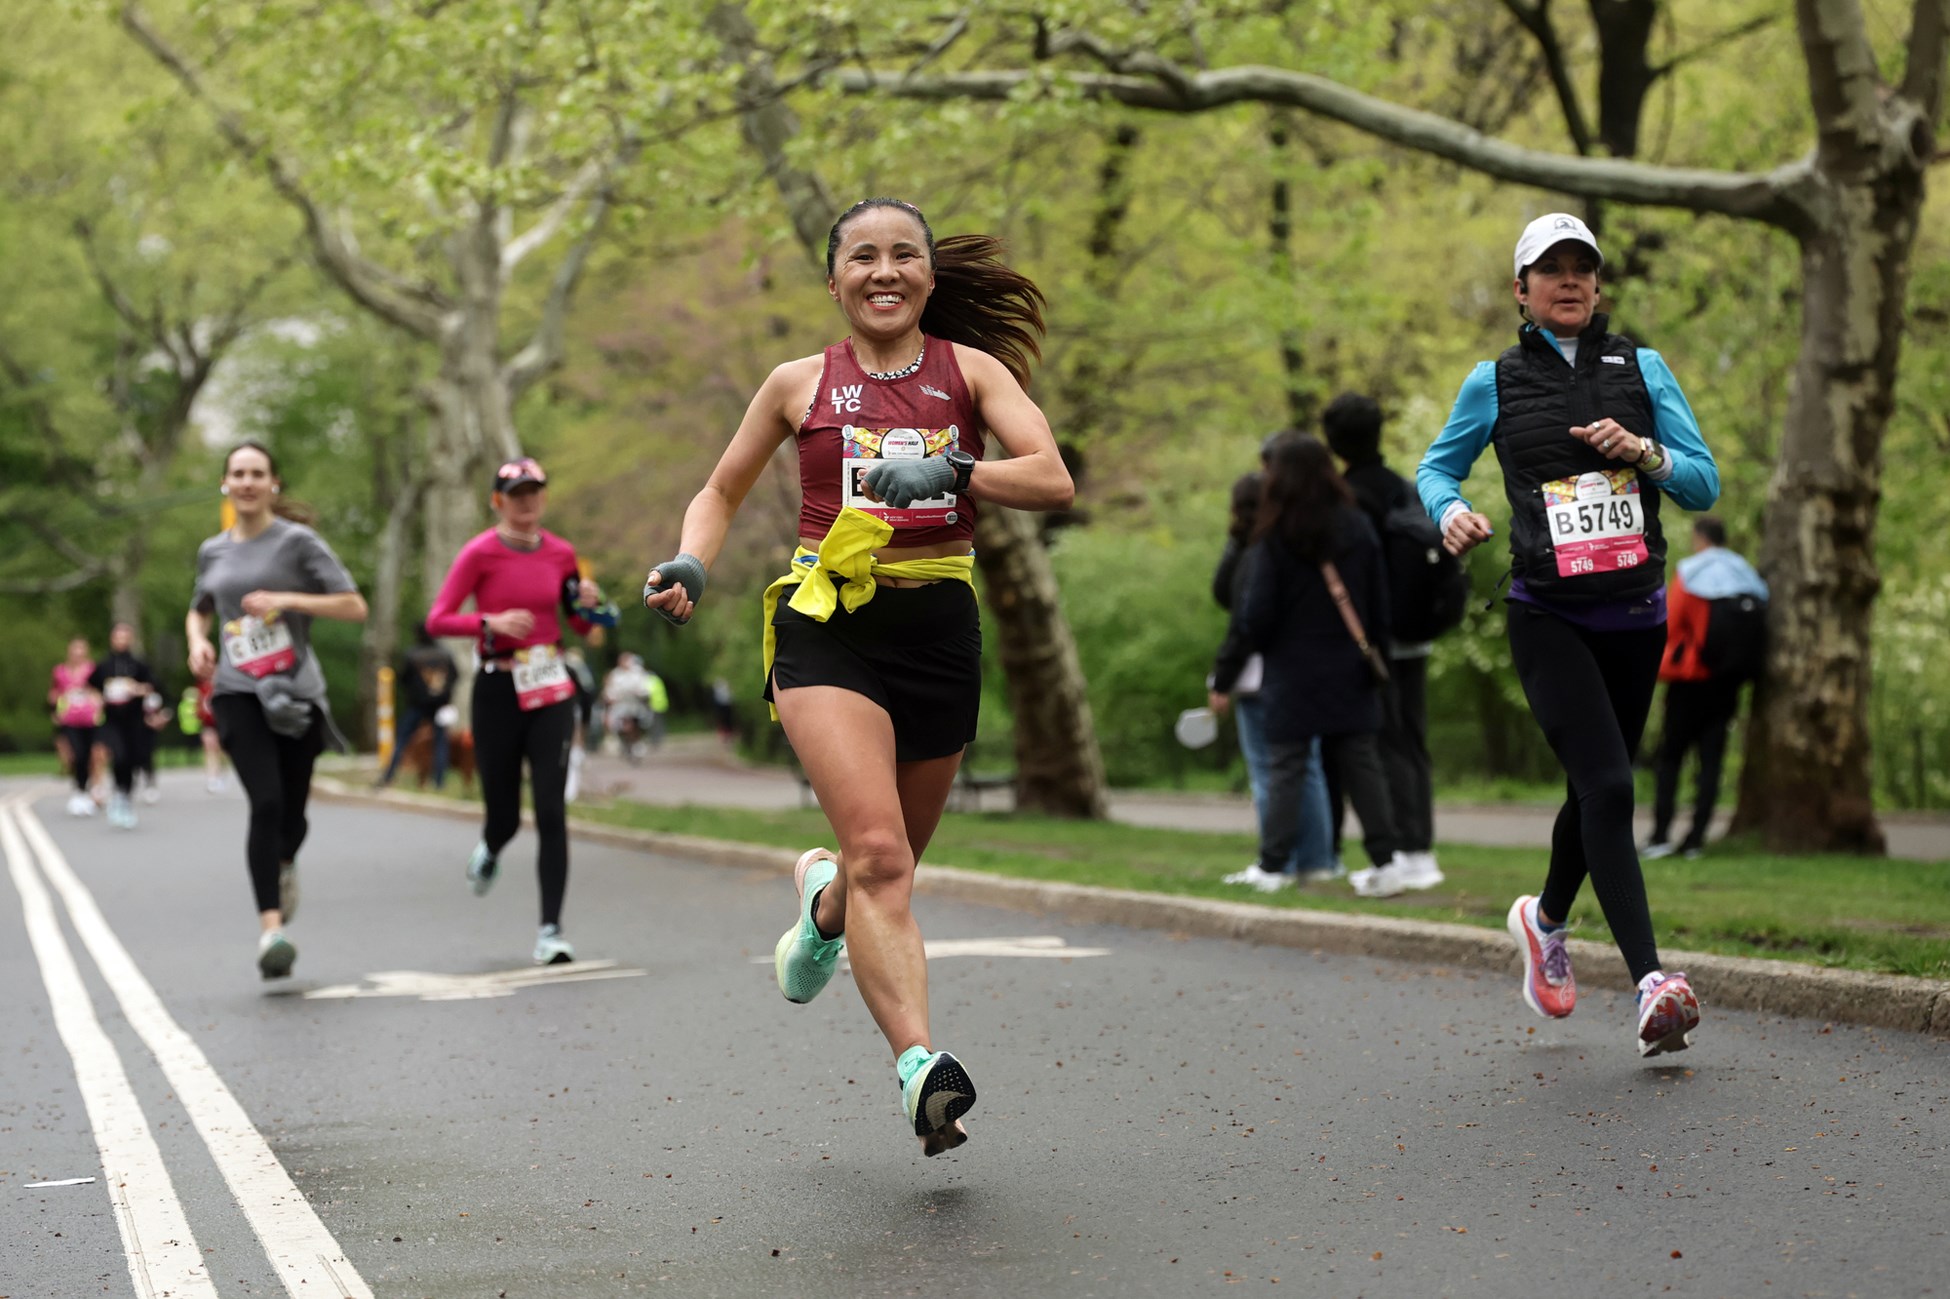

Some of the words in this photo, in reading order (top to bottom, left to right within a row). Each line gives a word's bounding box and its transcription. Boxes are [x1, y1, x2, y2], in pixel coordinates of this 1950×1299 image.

[831, 384, 863, 400] LW
[831, 399, 861, 414] TC
[1555, 512, 1574, 535] B
[1577, 500, 1634, 534] 5749
[1570, 559, 1594, 573] 5749
[1617, 553, 1638, 567] 5749
